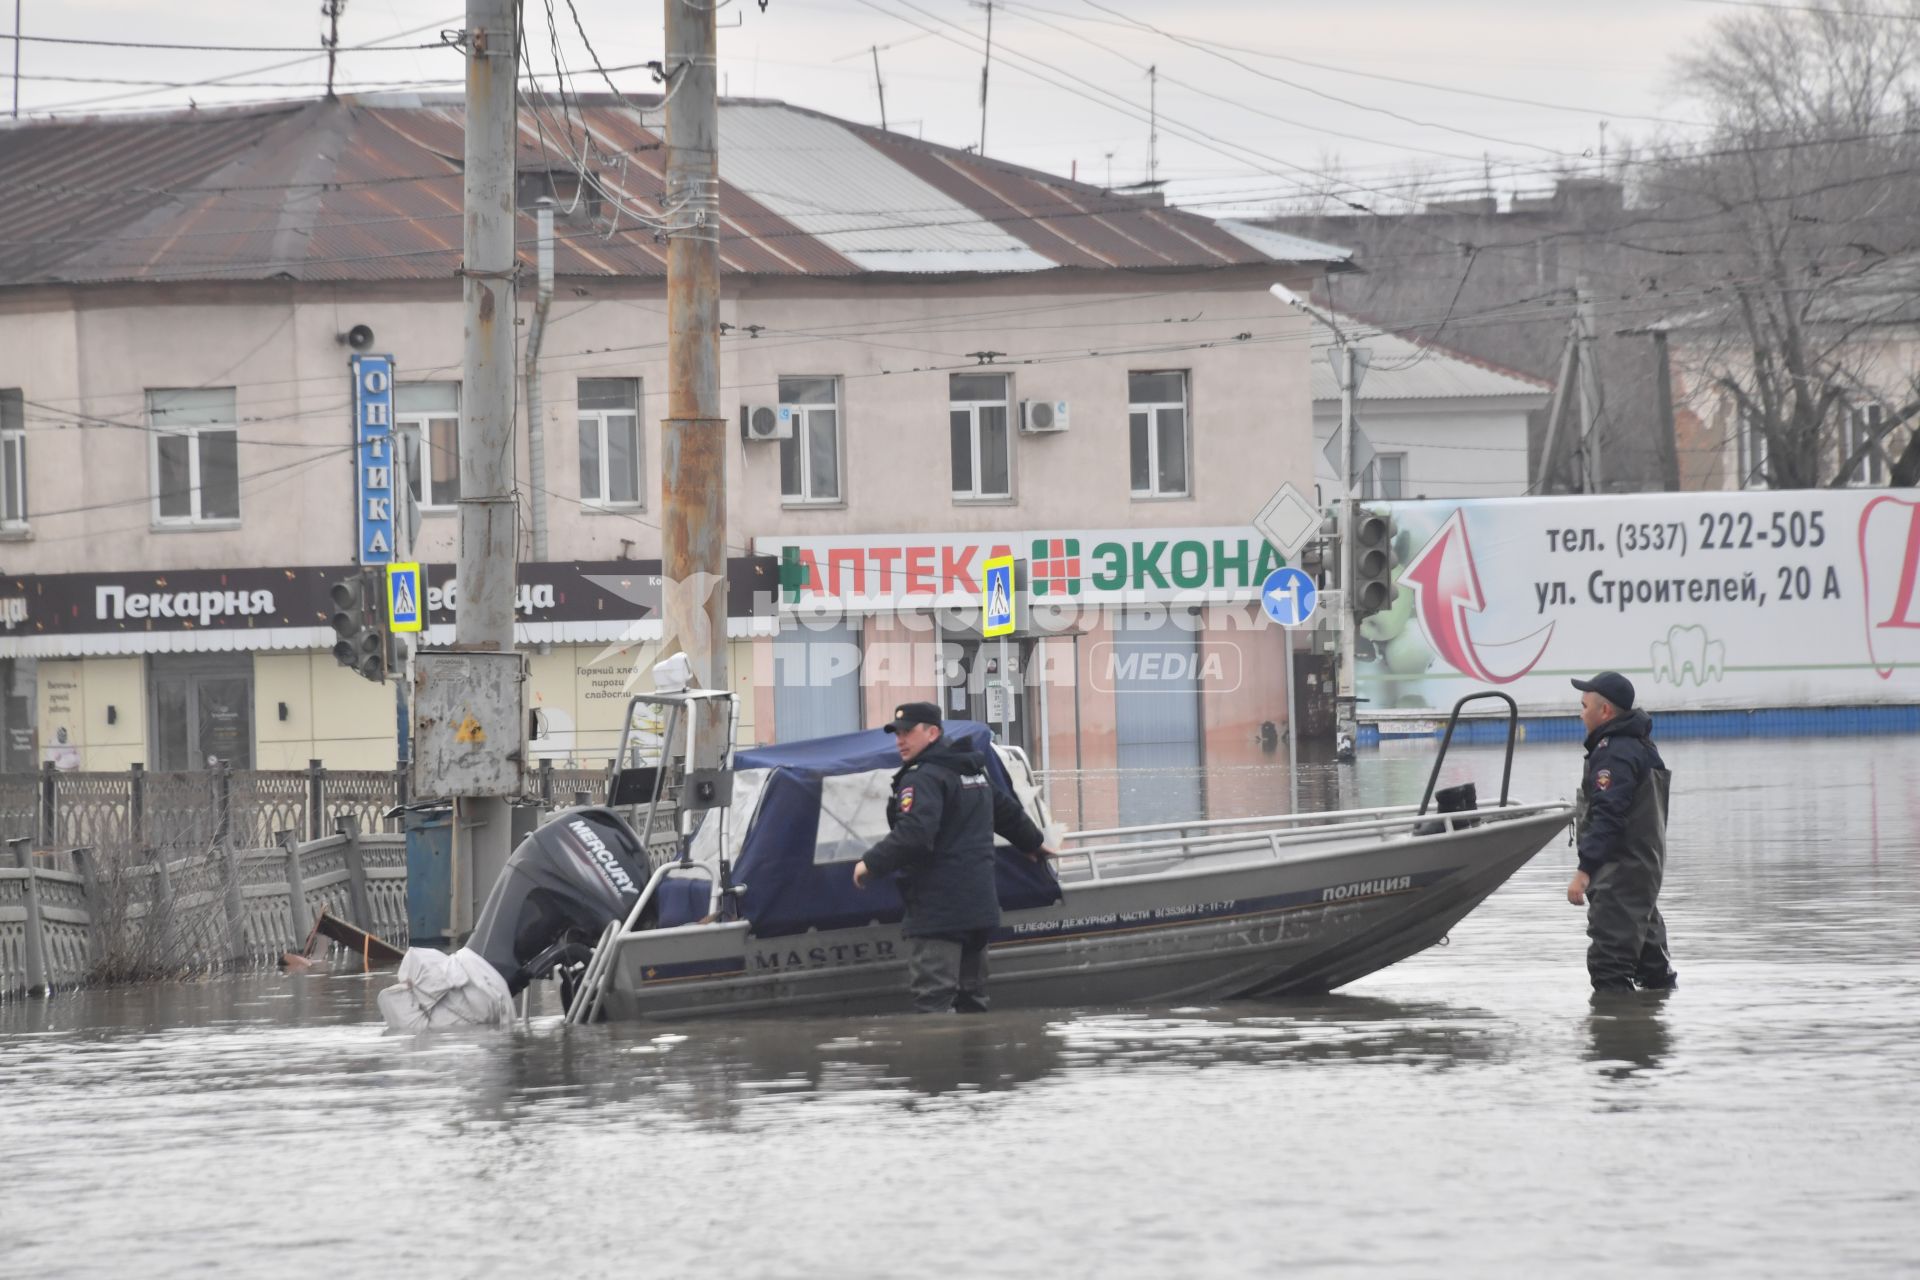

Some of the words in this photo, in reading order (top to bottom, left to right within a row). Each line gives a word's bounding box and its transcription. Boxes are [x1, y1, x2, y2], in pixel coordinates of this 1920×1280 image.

[364, 371, 390, 553] ОПТИКА
[1546, 527, 1605, 553] тел.
[1616, 521, 1687, 558] (3537)
[1700, 510, 1826, 550] 222-505
[96, 585, 276, 626] Пекарня
[1534, 580, 1576, 615] ул.
[1587, 570, 1767, 613] Строителей,
[1778, 565, 1812, 601] 20
[1823, 565, 1842, 600] А
[577, 666, 613, 677] Горячий
[617, 665, 639, 675] хлеб
[592, 679, 625, 689] пироги
[568, 820, 640, 895] MERCURY
[1013, 920, 1059, 933] ТЕЛЕФОН
[1061, 914, 1117, 929] ДЕЖУРНОЙ
[1119, 910, 1150, 922] ЧАСТИ
